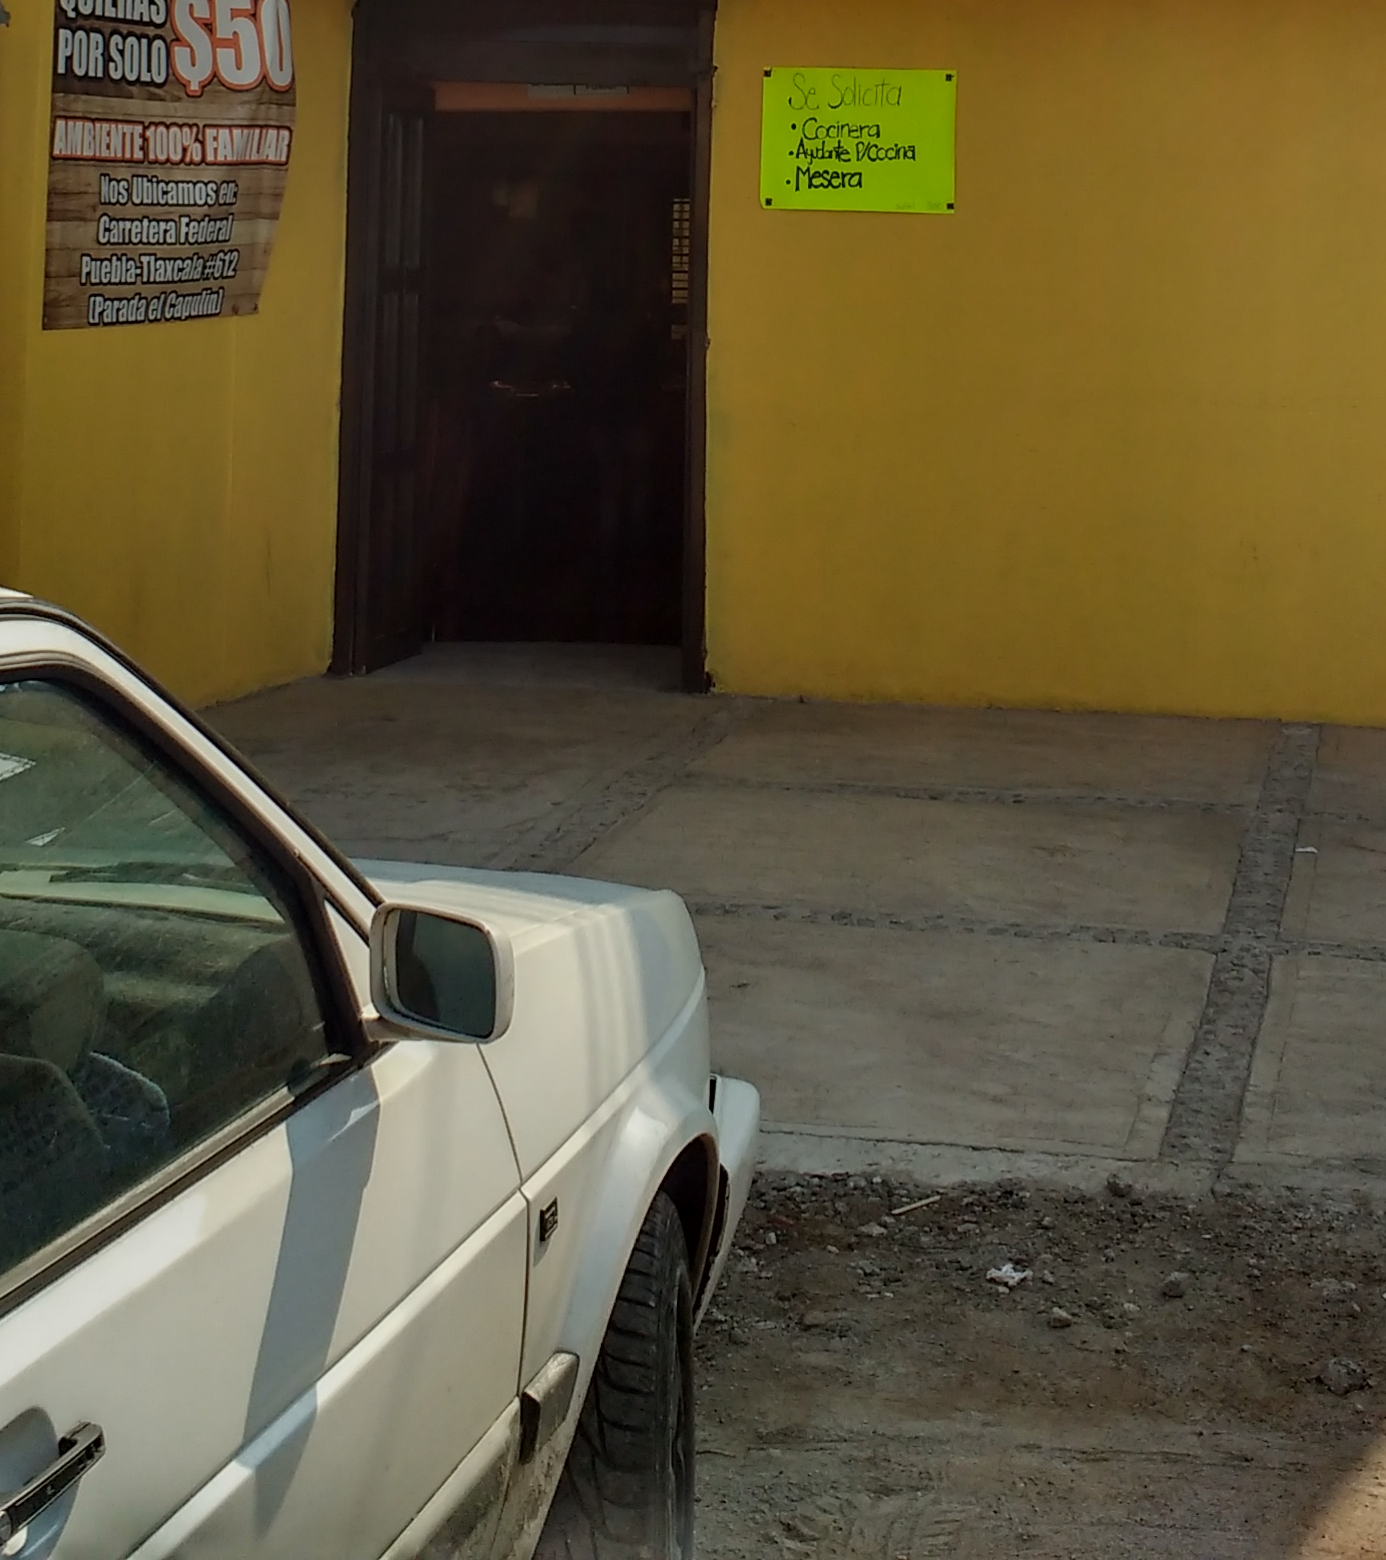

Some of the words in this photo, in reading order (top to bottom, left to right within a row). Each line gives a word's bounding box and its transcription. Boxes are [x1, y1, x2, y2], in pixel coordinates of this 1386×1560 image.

[56, 27, 104, 78] POR
[108, 34, 168, 87] SOLO
[788, 72, 820, 111] Se
[827, 73, 902, 109] Solicita
[52, 116, 144, 162] AMBIENTE
[145, 122, 203, 165] 100%
[204, 124, 291, 165] FAMILIAR
[801, 117, 881, 141] Cocinera
[99, 175, 129, 205] Nos
[131, 178, 216, 207] Ubicamos
[218, 179, 238, 204] en:
[794, 165, 863, 192] Mesera
[98, 215, 176, 246] Carretera
[178, 215, 232, 244] Federal
[80, 254, 202, 285] Puebla-Tlaxcala
[202, 251, 239, 280] #612
[88, 295, 146, 327] (Parada
[148, 293, 164, 320] el
